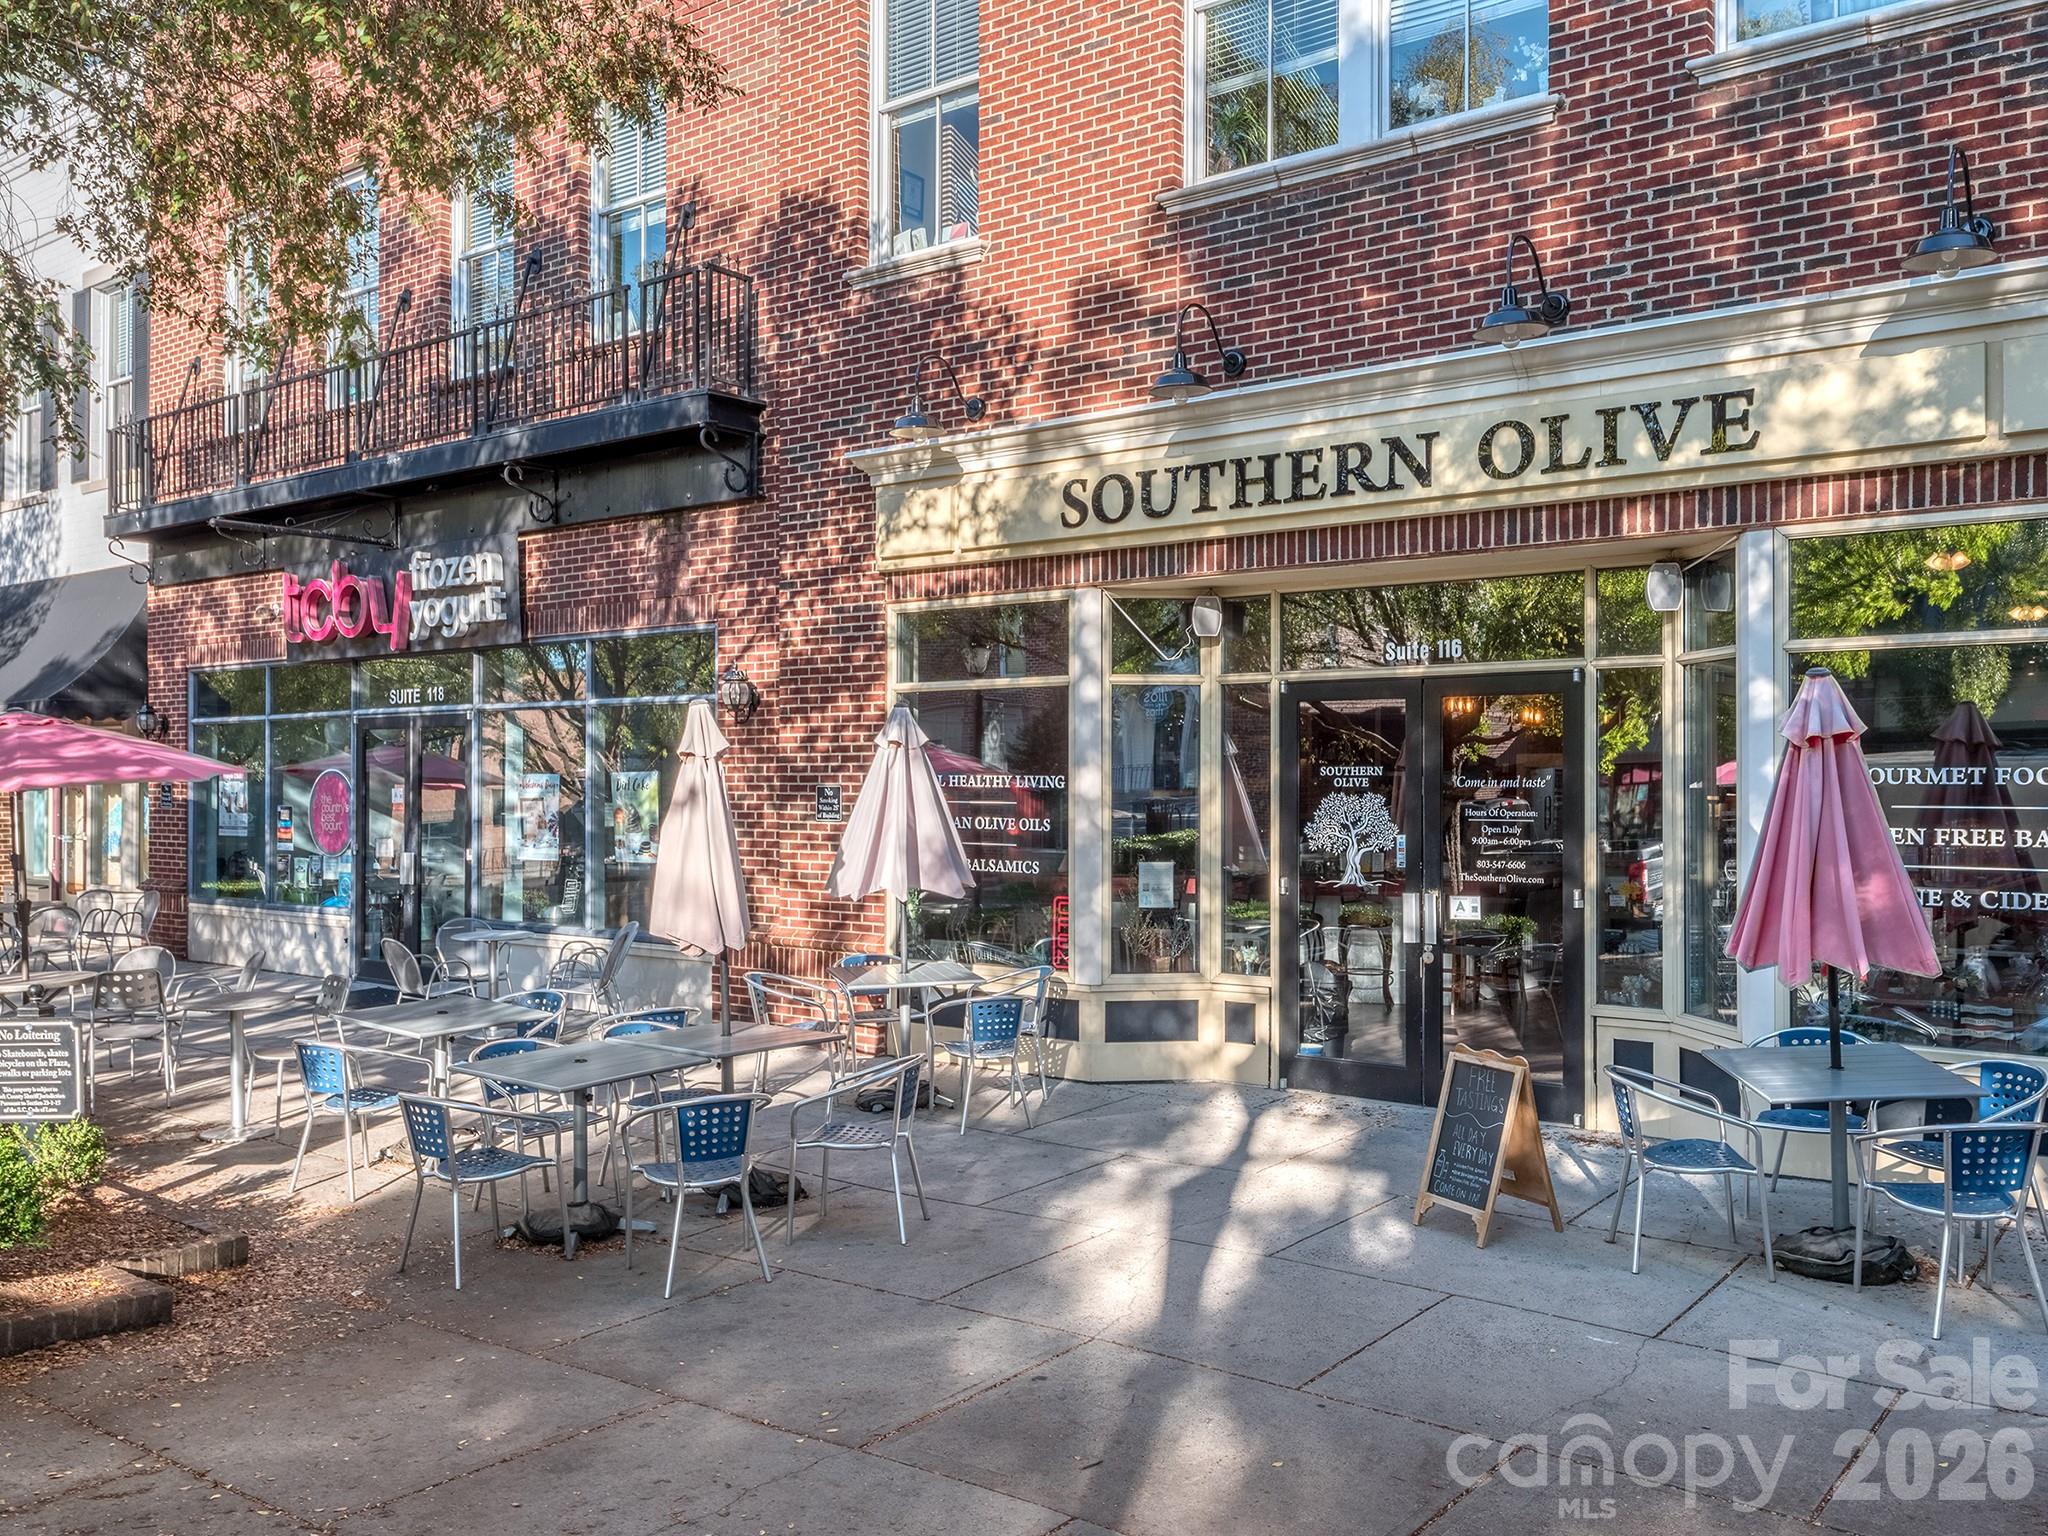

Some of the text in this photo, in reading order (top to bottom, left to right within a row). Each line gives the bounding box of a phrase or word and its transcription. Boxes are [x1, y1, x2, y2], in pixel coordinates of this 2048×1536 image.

[1059, 387, 1761, 529] SOUTHERN OLIVE
[409, 551, 504, 591] frozen
[283, 559, 413, 651] tcby
[409, 586, 507, 641] yogurt
[1385, 639, 1462, 660] Suite 116
[389, 687, 445, 705] SUITE 118
[1320, 766, 1384, 776] SOUTHERN
[1869, 767, 2048, 786] OURMET FOO
[938, 775, 1066, 789] L HEALTHY LIVING
[1333, 777, 1370, 787] OLIVE
[1487, 777, 1497, 788] in
[1500, 776, 1520, 788] and
[321, 793, 332, 804] the
[824, 787, 833, 796] No
[321, 813, 336, 822] best
[1465, 808, 1539, 819] Hours Of Operation:
[320, 821, 343, 834] yogurt
[954, 816, 1051, 832] AN OLIVE OILS
[1481, 825, 1522, 837] Open Daily
[1889, 828, 2048, 848] EN FREE BA
[1476, 860, 1526, 870] 803-547-6606
[1459, 872, 1545, 883] TheSouthernOlive.com
[1456, 900, 1466, 912] A
[1951, 889, 1972, 908] &
[1979, 890, 2048, 911] CIDE
[0, 1028, 61, 1042] No Loitering
[2, 1048, 69, 1058] Skateboards, skates
[36, 1058, 48, 1067] the
[48, 1058, 71, 1068] Plaza,
[30, 1068, 58, 1079] parking
[57, 1068, 72, 1077] lots
[1468, 1066, 1497, 1093] FREE
[1456, 1087, 1505, 1114] TASTINGS
[1452, 1123, 1487, 1146] ALL DAY
[1434, 1180, 1456, 1196] COME
[1456, 1187, 1467, 1199] ON
